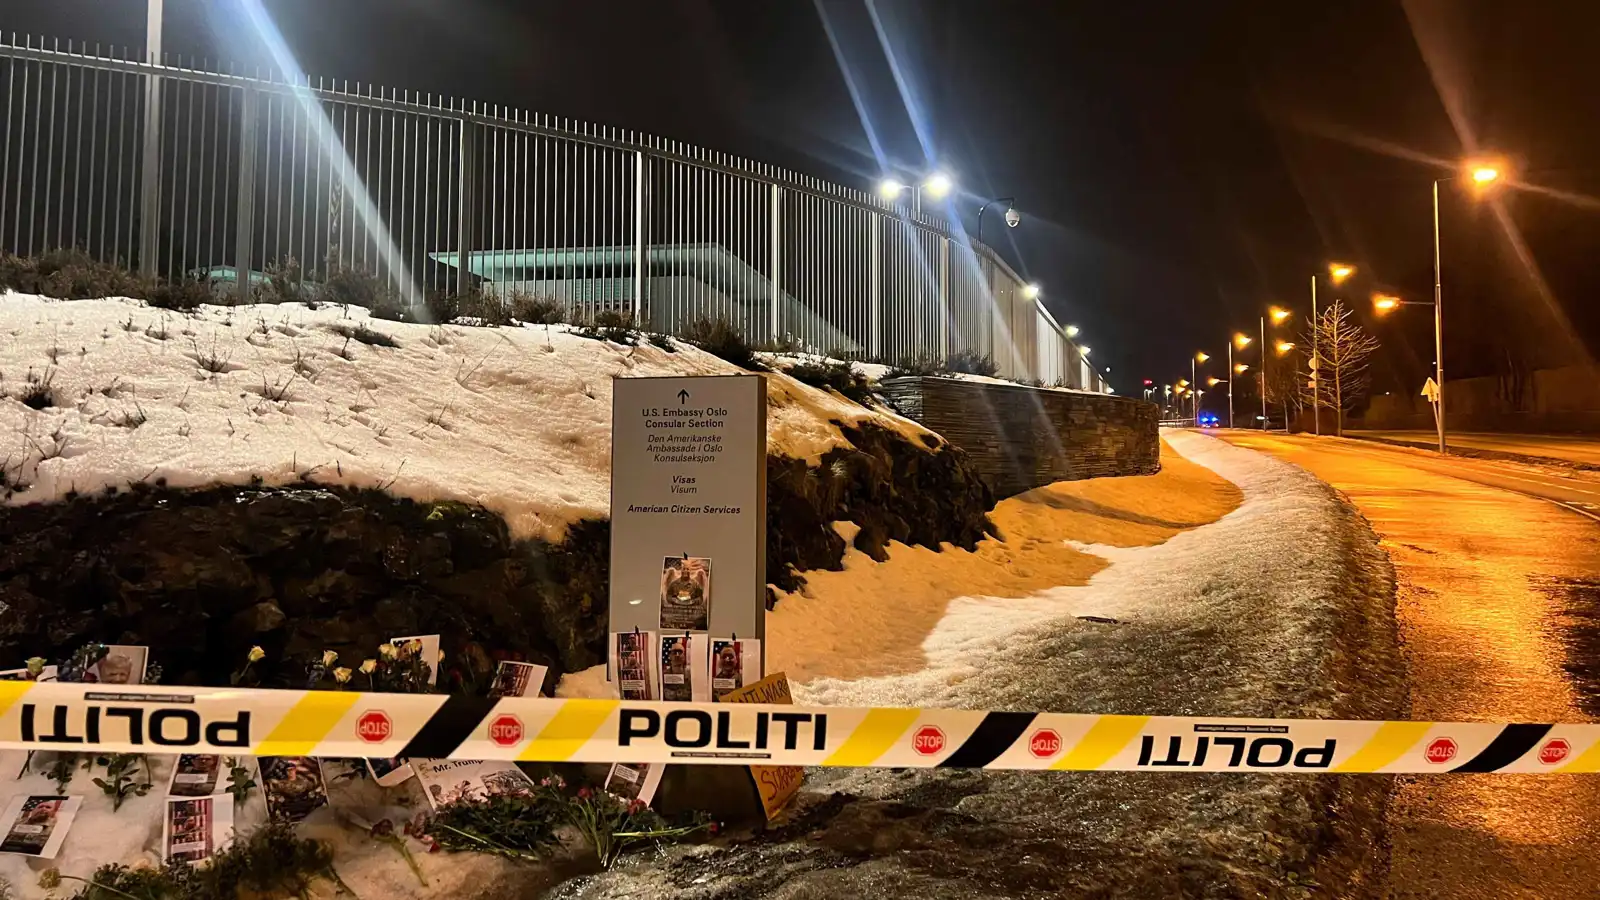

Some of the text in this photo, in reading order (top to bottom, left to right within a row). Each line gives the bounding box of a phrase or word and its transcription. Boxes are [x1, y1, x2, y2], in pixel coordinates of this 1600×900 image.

[642, 407, 728, 418] U.S. Embassy Oslo
[645, 419, 724, 428] Consular Section
[648, 434, 722, 443] Den Amerikanske
[646, 444, 696, 452] Ambassade
[703, 443, 723, 452] Oslo
[653, 454, 715, 463] Konsulseksjon
[672, 476, 696, 484] Visas
[671, 485, 698, 494] Visum
[627, 504, 741, 514] American Citizen Services
[21, 704, 250, 746] POLITI
[359, 720, 389, 735] STOP
[619, 709, 826, 750] POLITI
[492, 724, 520, 738] STOP
[915, 735, 943, 747] STOP
[1032, 739, 1059, 751] STOP
[1138, 735, 1336, 767] POLITI
[1427, 745, 1456, 757] STOP
[1541, 746, 1568, 758] STOP
[433, 764, 451, 773] Mr.
